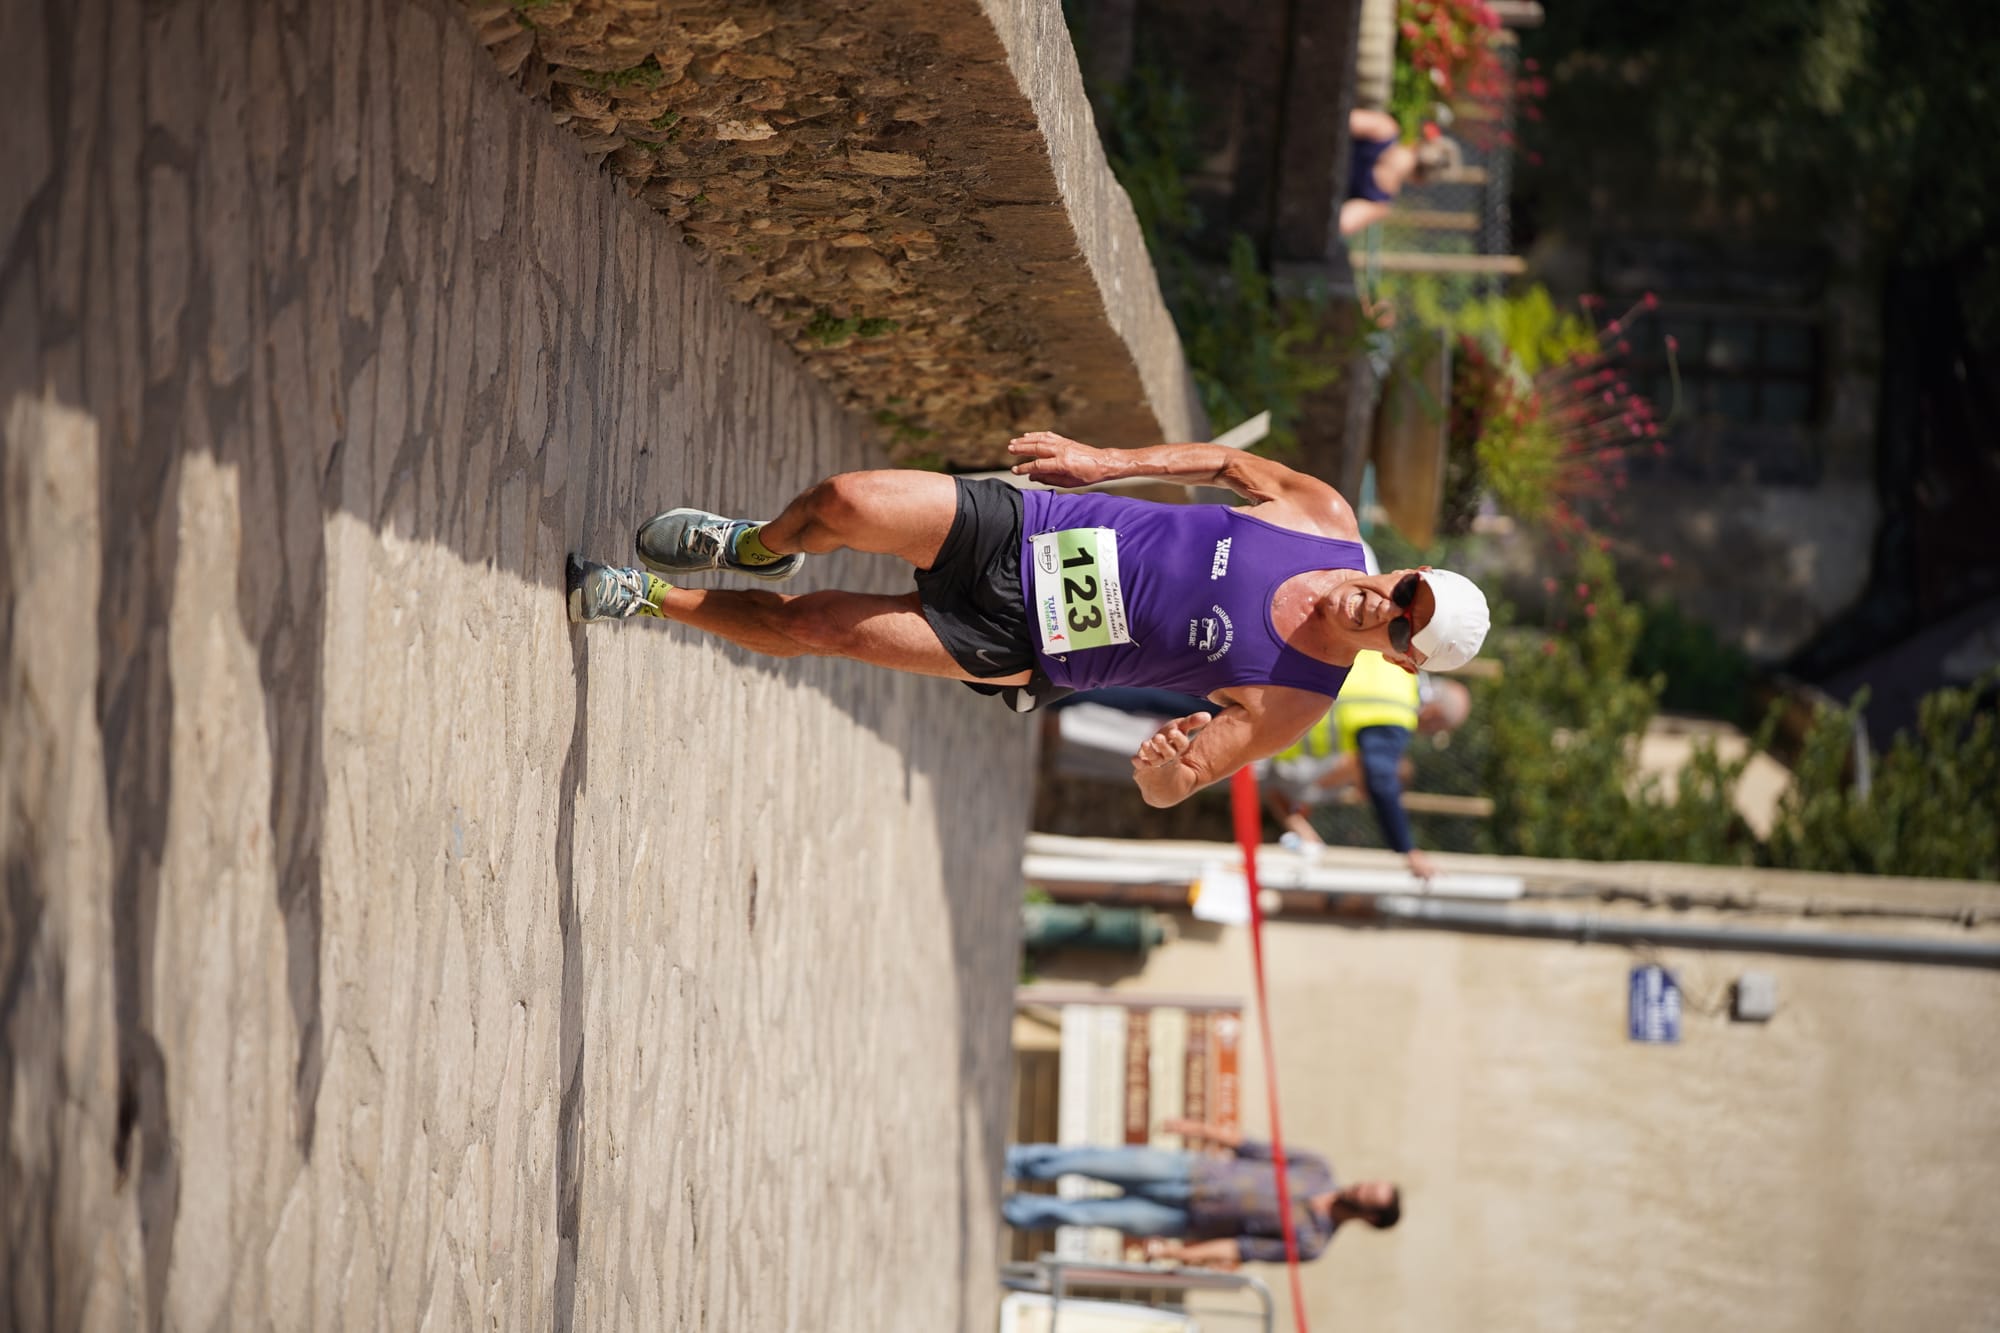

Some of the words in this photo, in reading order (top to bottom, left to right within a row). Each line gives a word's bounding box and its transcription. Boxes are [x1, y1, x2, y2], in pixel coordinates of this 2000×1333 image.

[1218, 537, 1232, 576] TUFF'S
[1062, 547, 1102, 633] 123
[1048, 595, 1059, 631] TUFF'S
[1212, 604, 1233, 630] COURSE
[1225, 630, 1234, 641] DU
[1207, 642, 1231, 663] DOLMEN
